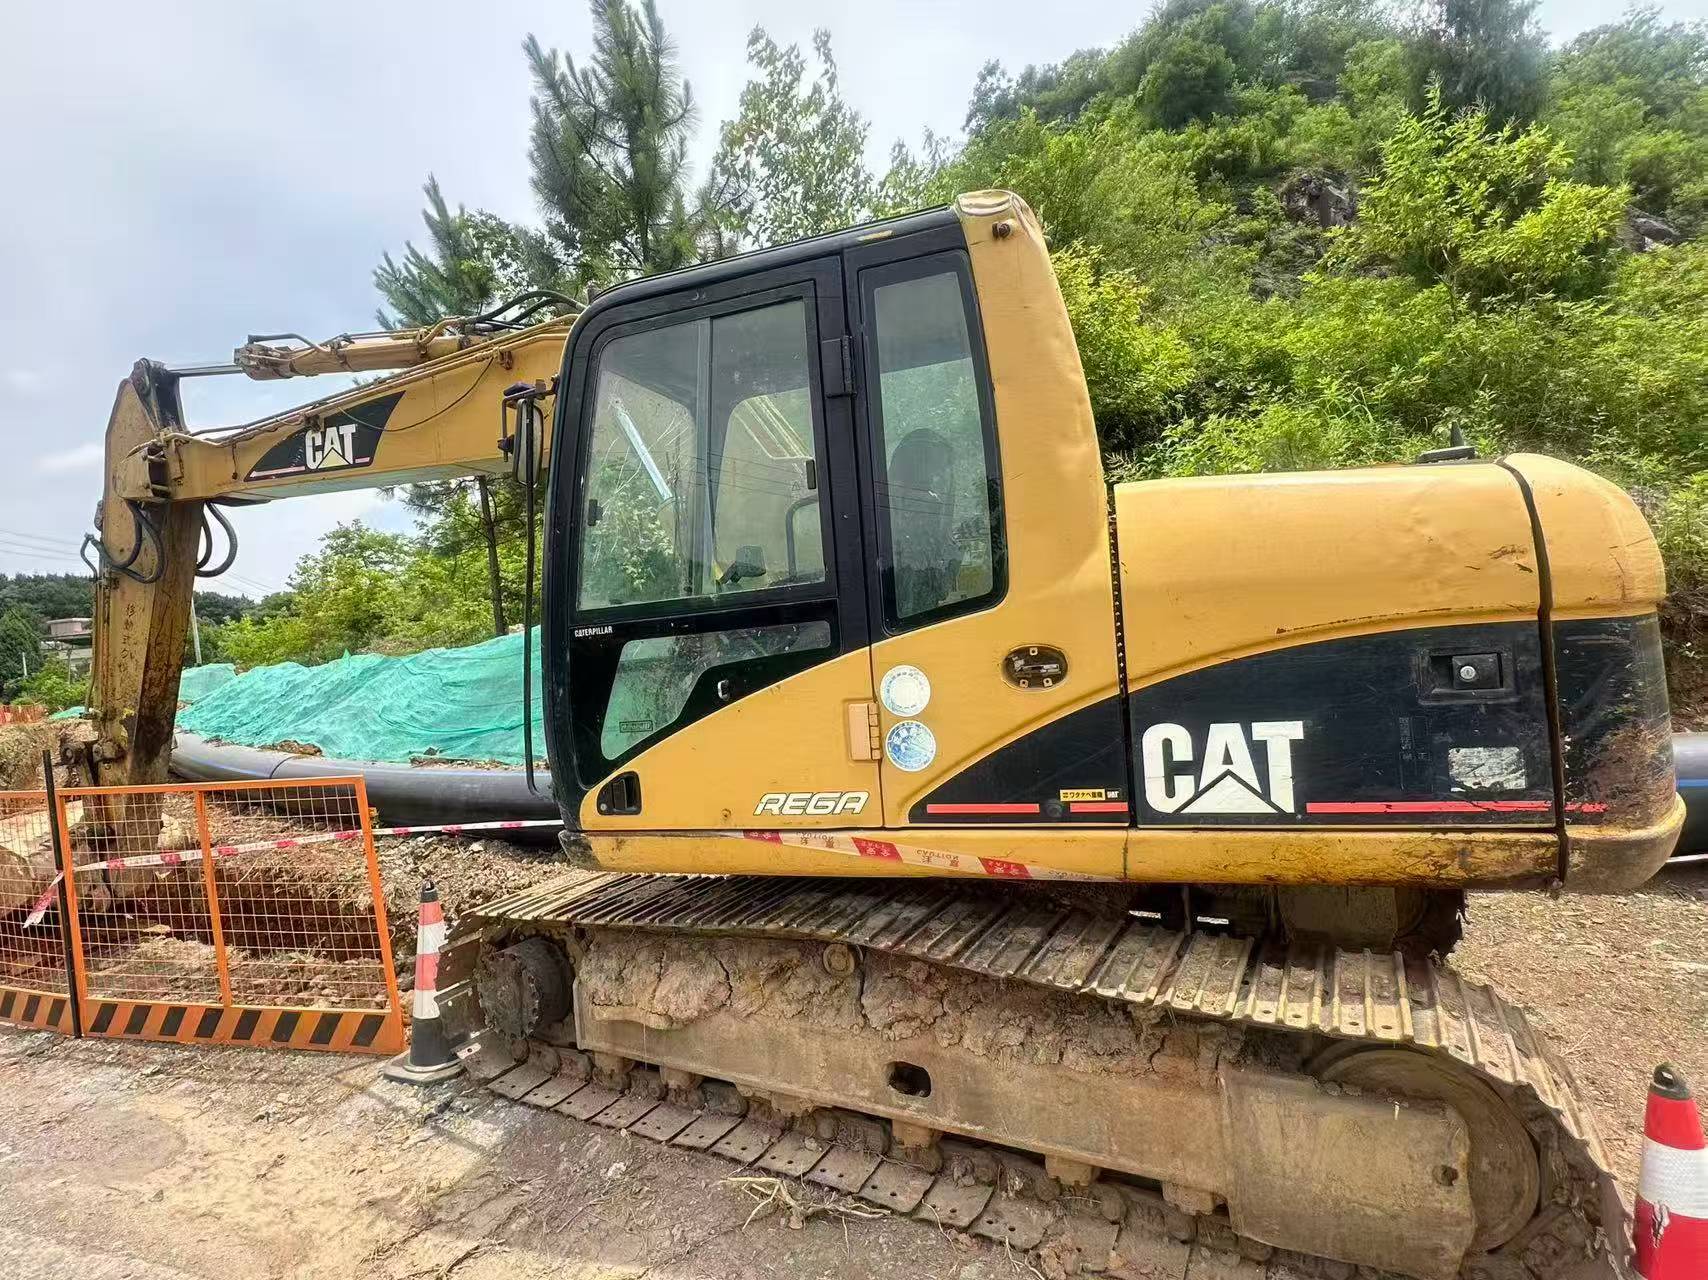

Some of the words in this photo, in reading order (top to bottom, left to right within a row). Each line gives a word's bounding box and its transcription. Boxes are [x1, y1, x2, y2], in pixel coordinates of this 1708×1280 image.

[305, 424, 356, 470] CAT
[574, 625, 613, 637] CATERPILLAR
[1142, 721, 1304, 814] CAT
[753, 791, 870, 816] REGA
